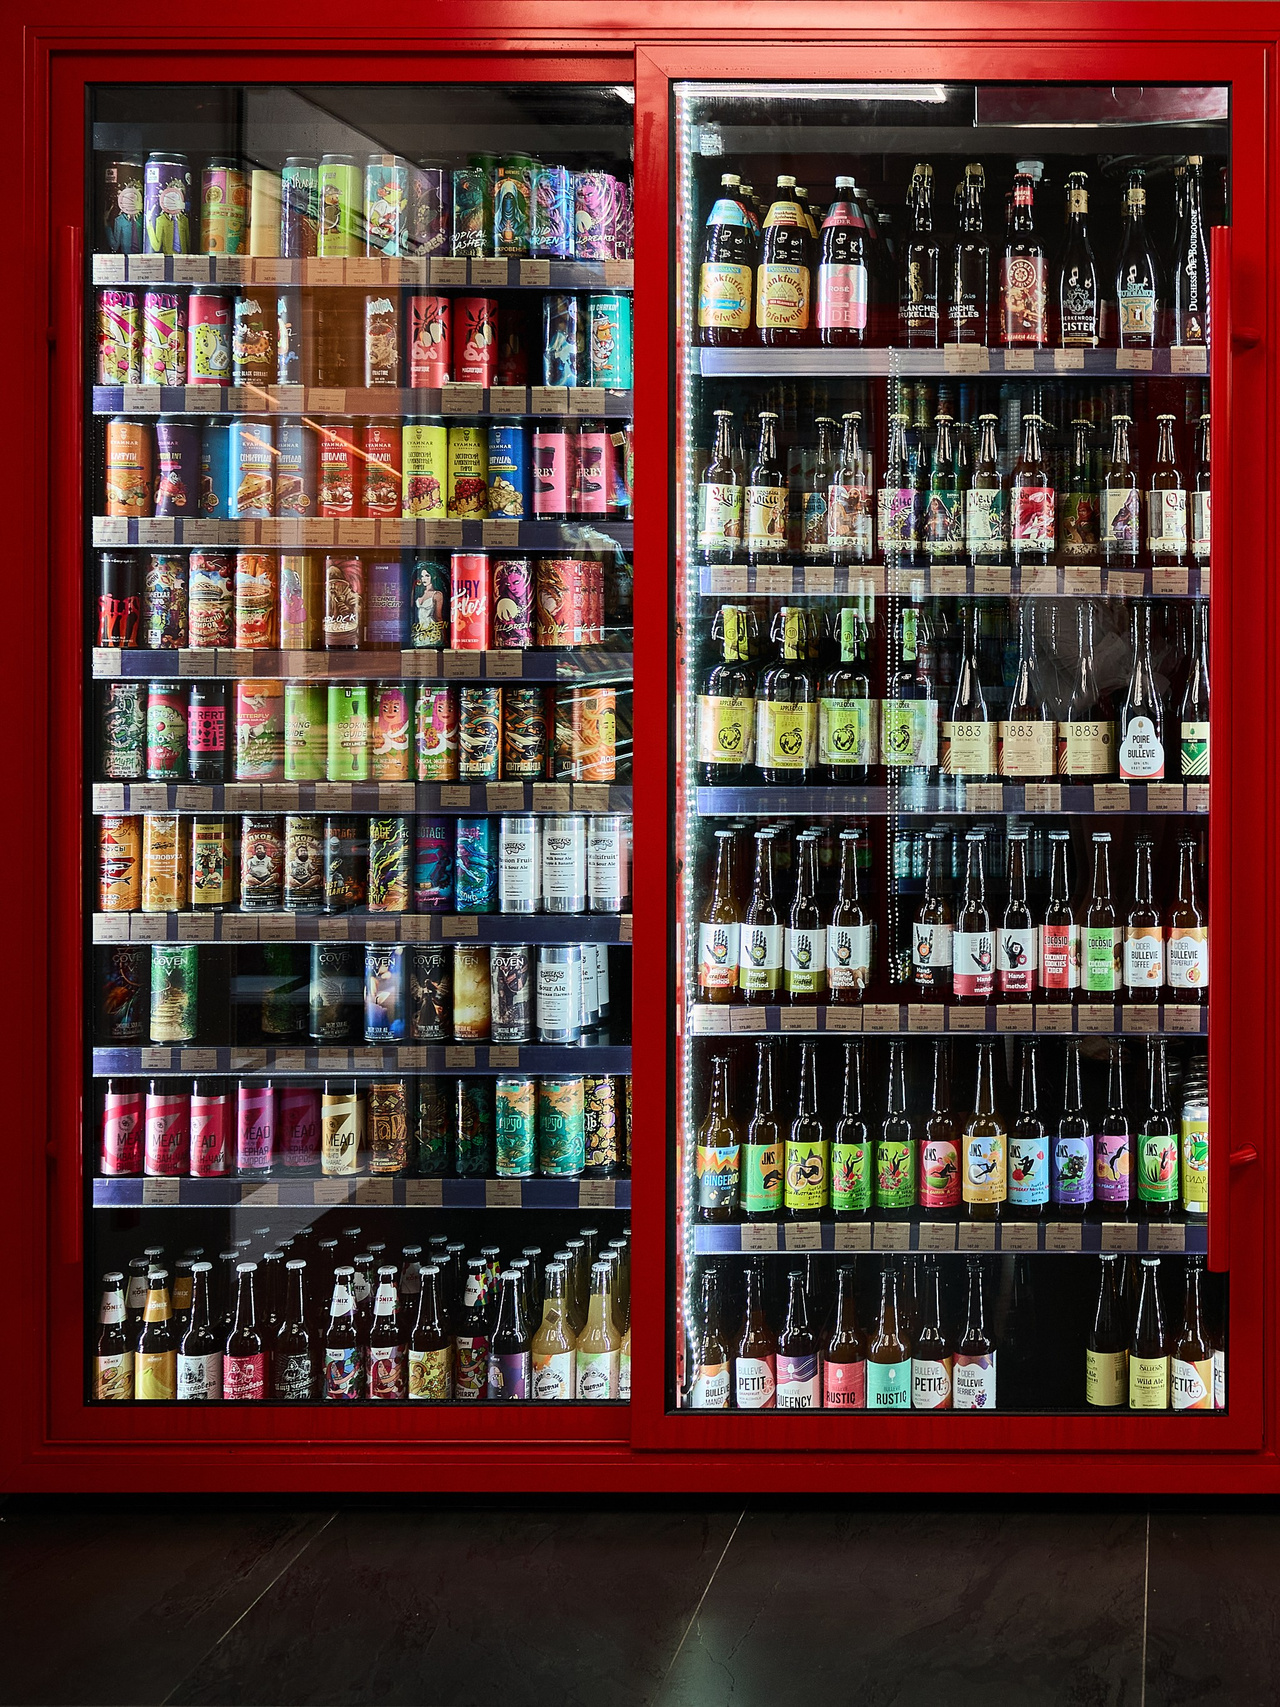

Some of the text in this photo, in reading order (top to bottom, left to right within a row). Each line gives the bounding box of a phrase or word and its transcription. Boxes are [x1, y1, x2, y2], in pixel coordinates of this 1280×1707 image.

[1189, 209, 1199, 256] BOURGOGNE
[952, 725, 982, 737] 1883
[1005, 725, 1033, 737] 1883
[1070, 725, 1099, 737] 1883
[1132, 735, 1151, 744] POIRE
[1128, 750, 1156, 759] BULLEVIE
[1136, 942, 1151, 950] CIDER
[1131, 951, 1159, 959] BULLEVIE
[1170, 950, 1198, 959] BULLEVIE
[153, 956, 188, 966] COVEN
[365, 957, 396, 967] COVEN
[413, 956, 446, 965] COVEN
[492, 957, 524, 967] COVEN
[1131, 960, 1150, 968] TOFFEE
[241, 1126, 271, 1140] MEAD
[117, 1133, 141, 1146] MEA
[326, 1132, 355, 1147] MEAD
[739, 1366, 763, 1375] BULLEVIE
[915, 1366, 939, 1375] BULLEVIE
[961, 1370, 975, 1378] CIDER
[739, 1376, 766, 1392] PETIT
[915, 1376, 942, 1392] PETIT
[957, 1378, 984, 1387] BULLEVIE
[1137, 1377, 1164, 1385] Wild Ale
[705, 1388, 730, 1398] BULLEVIE
[957, 1388, 976, 1396] BERRIES
